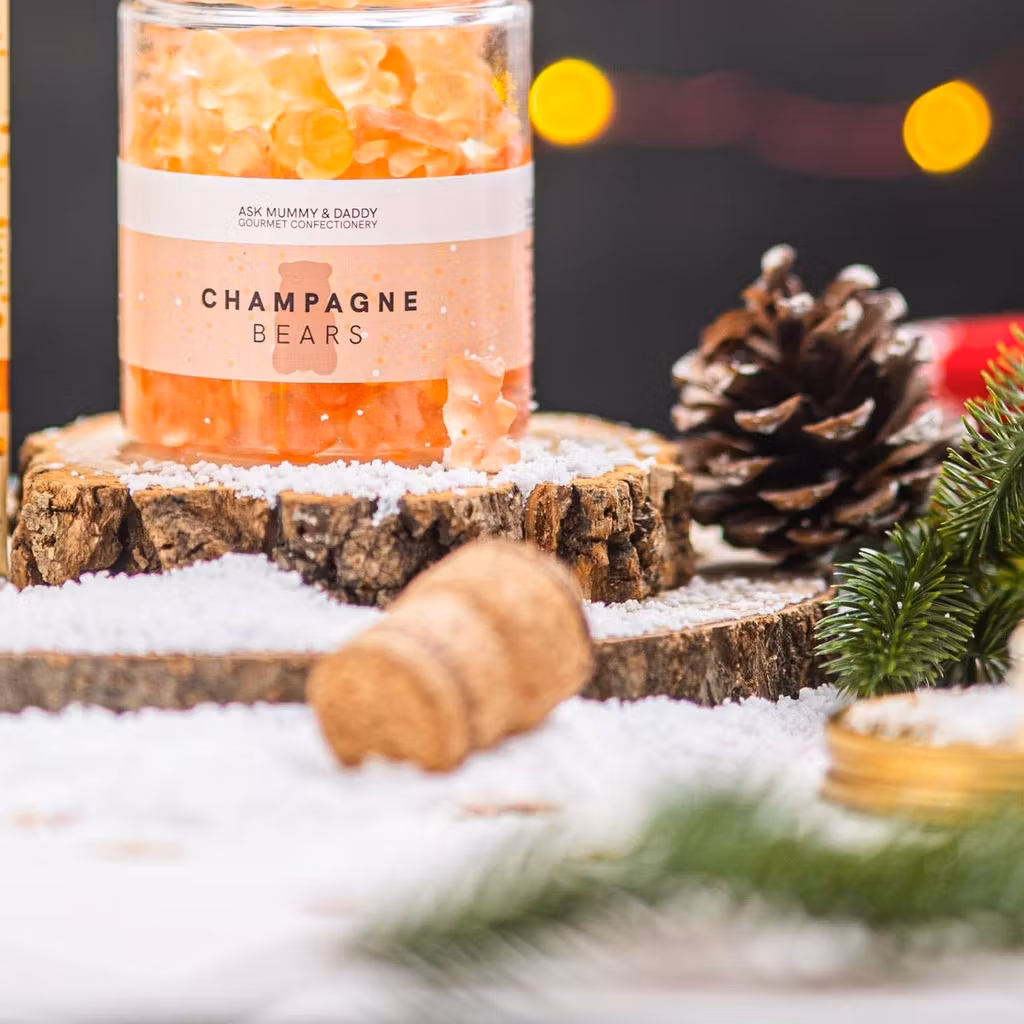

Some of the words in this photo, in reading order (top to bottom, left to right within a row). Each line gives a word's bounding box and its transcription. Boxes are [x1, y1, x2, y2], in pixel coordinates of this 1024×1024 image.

[238, 206, 262, 217] ASK
[266, 207, 318, 219] MUMMY
[321, 208, 330, 219] &
[334, 207, 378, 219] DADDY
[238, 218, 288, 229] GOURMET
[290, 219, 378, 230] CONFECTIONERY
[201, 288, 418, 313] CHAMPAGNE
[253, 323, 363, 345] BEARS
